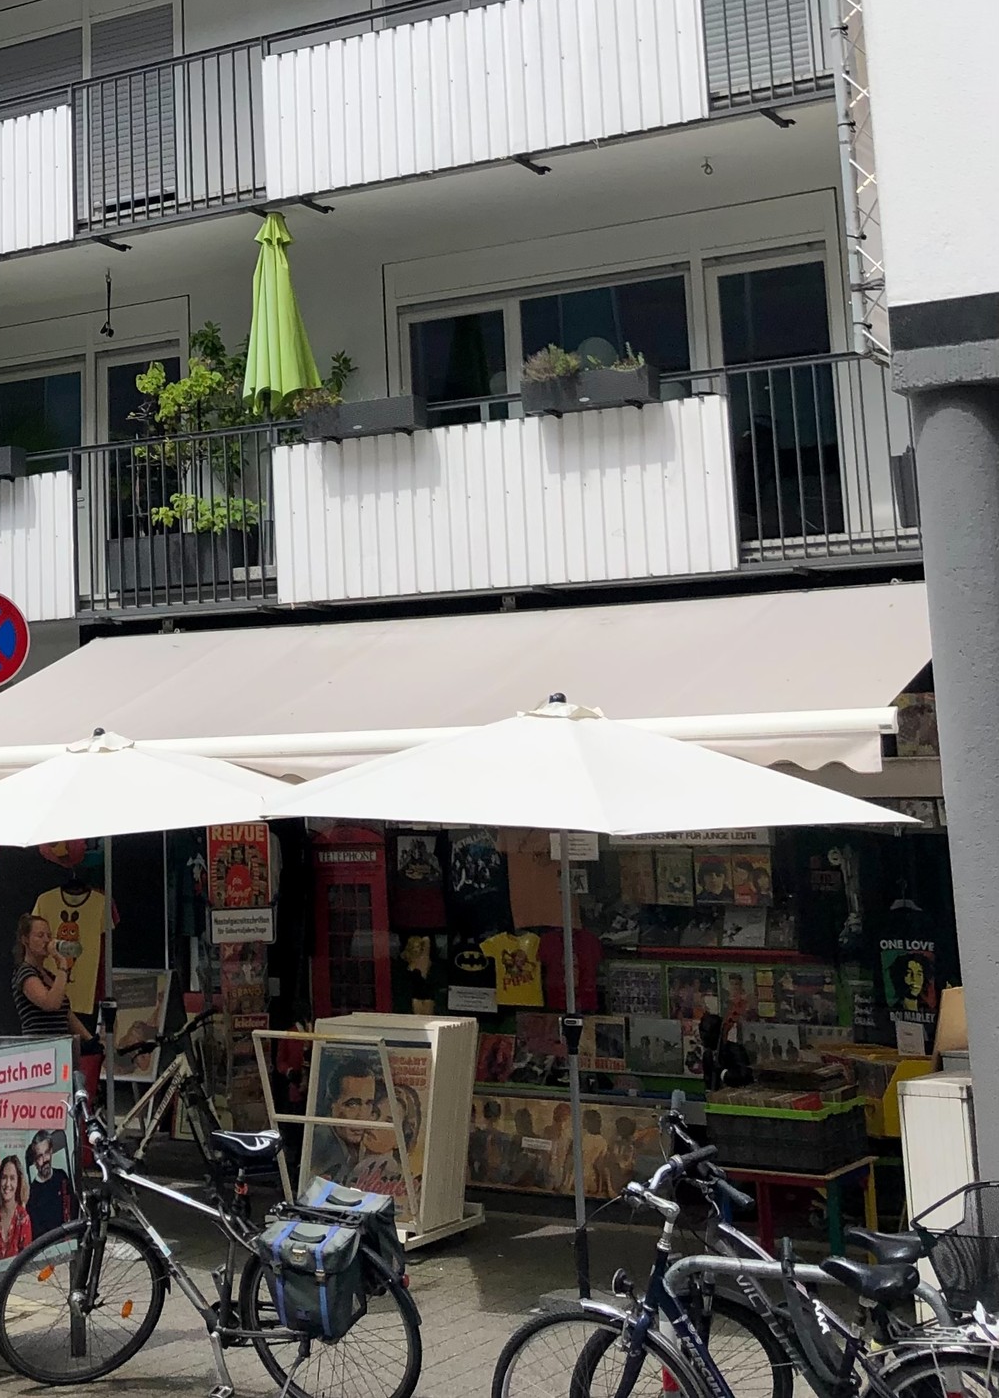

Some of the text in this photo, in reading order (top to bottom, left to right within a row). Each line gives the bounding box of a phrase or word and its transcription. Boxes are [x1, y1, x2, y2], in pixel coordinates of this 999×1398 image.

[211, 825, 266, 843] REVUE
[686, 830, 702, 840] FÜR
[703, 831, 729, 840] JUNGE
[730, 831, 757, 840] LEUTE
[319, 851, 376, 863] TELEPHONE
[880, 939, 936, 952] ONE LOVE
[904, 1010, 937, 1023] MARLEY
[31, 1061, 52, 1079] me
[11, 1104, 36, 1123] you
[40, 1103, 64, 1120] can
[681, 1335, 728, 1398] HERCUL
